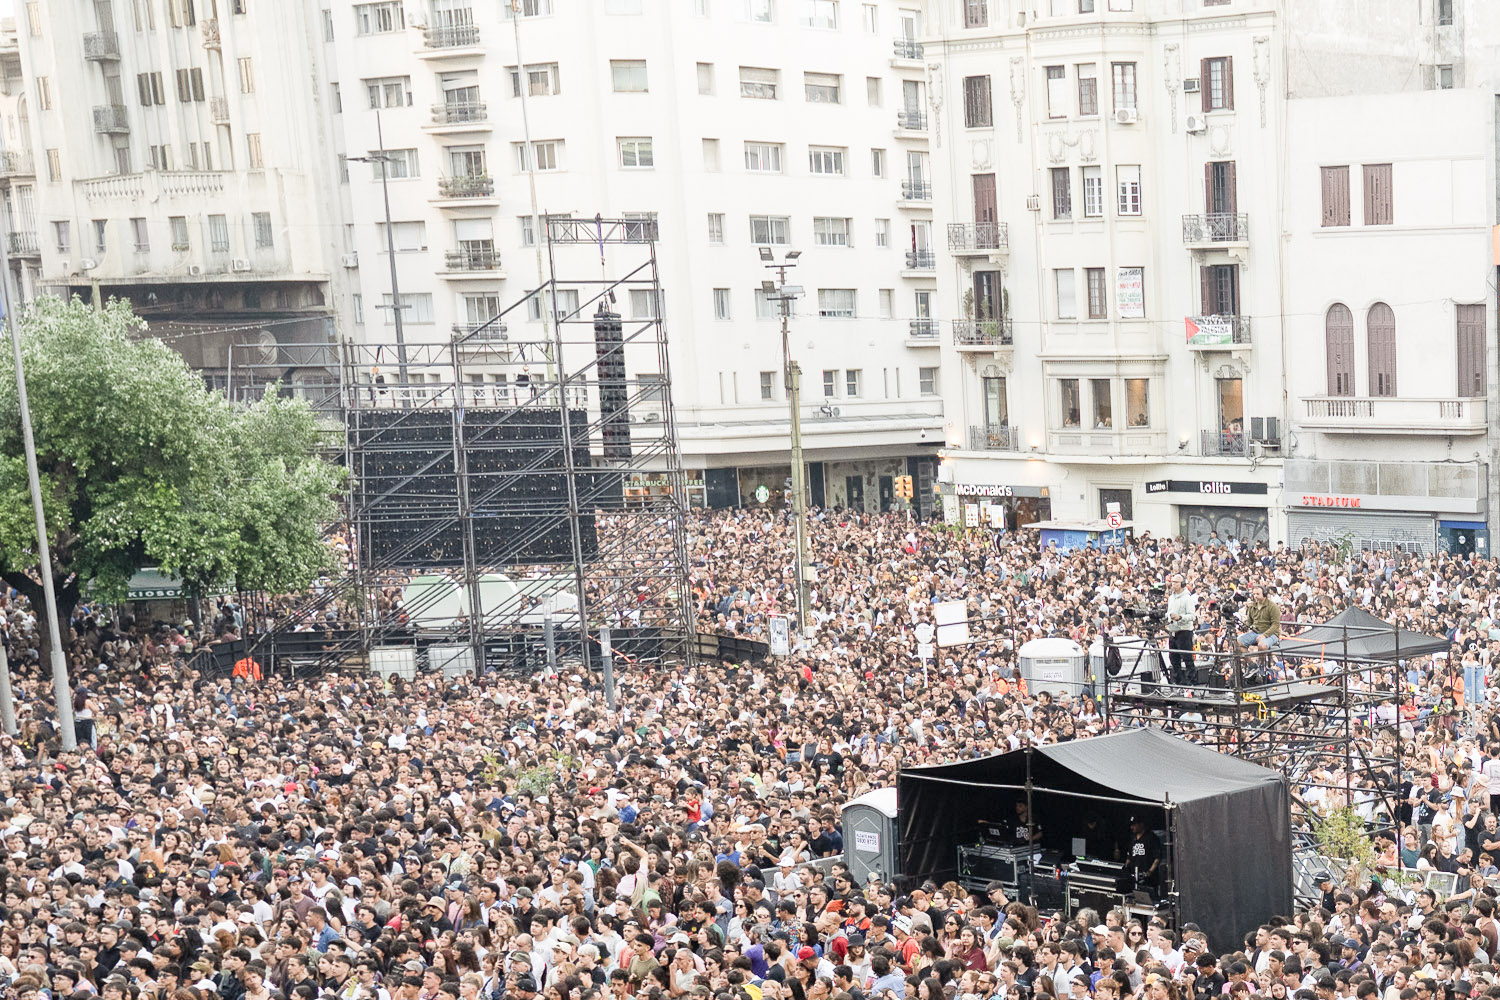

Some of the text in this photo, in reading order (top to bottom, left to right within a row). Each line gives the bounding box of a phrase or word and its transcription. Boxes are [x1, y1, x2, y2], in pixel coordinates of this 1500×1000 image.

[955, 483, 1014, 496] McDonald's
[1150, 483, 1166, 492] Lolita
[1200, 481, 1231, 494] Lolita
[1302, 495, 1361, 507] STADIUM
